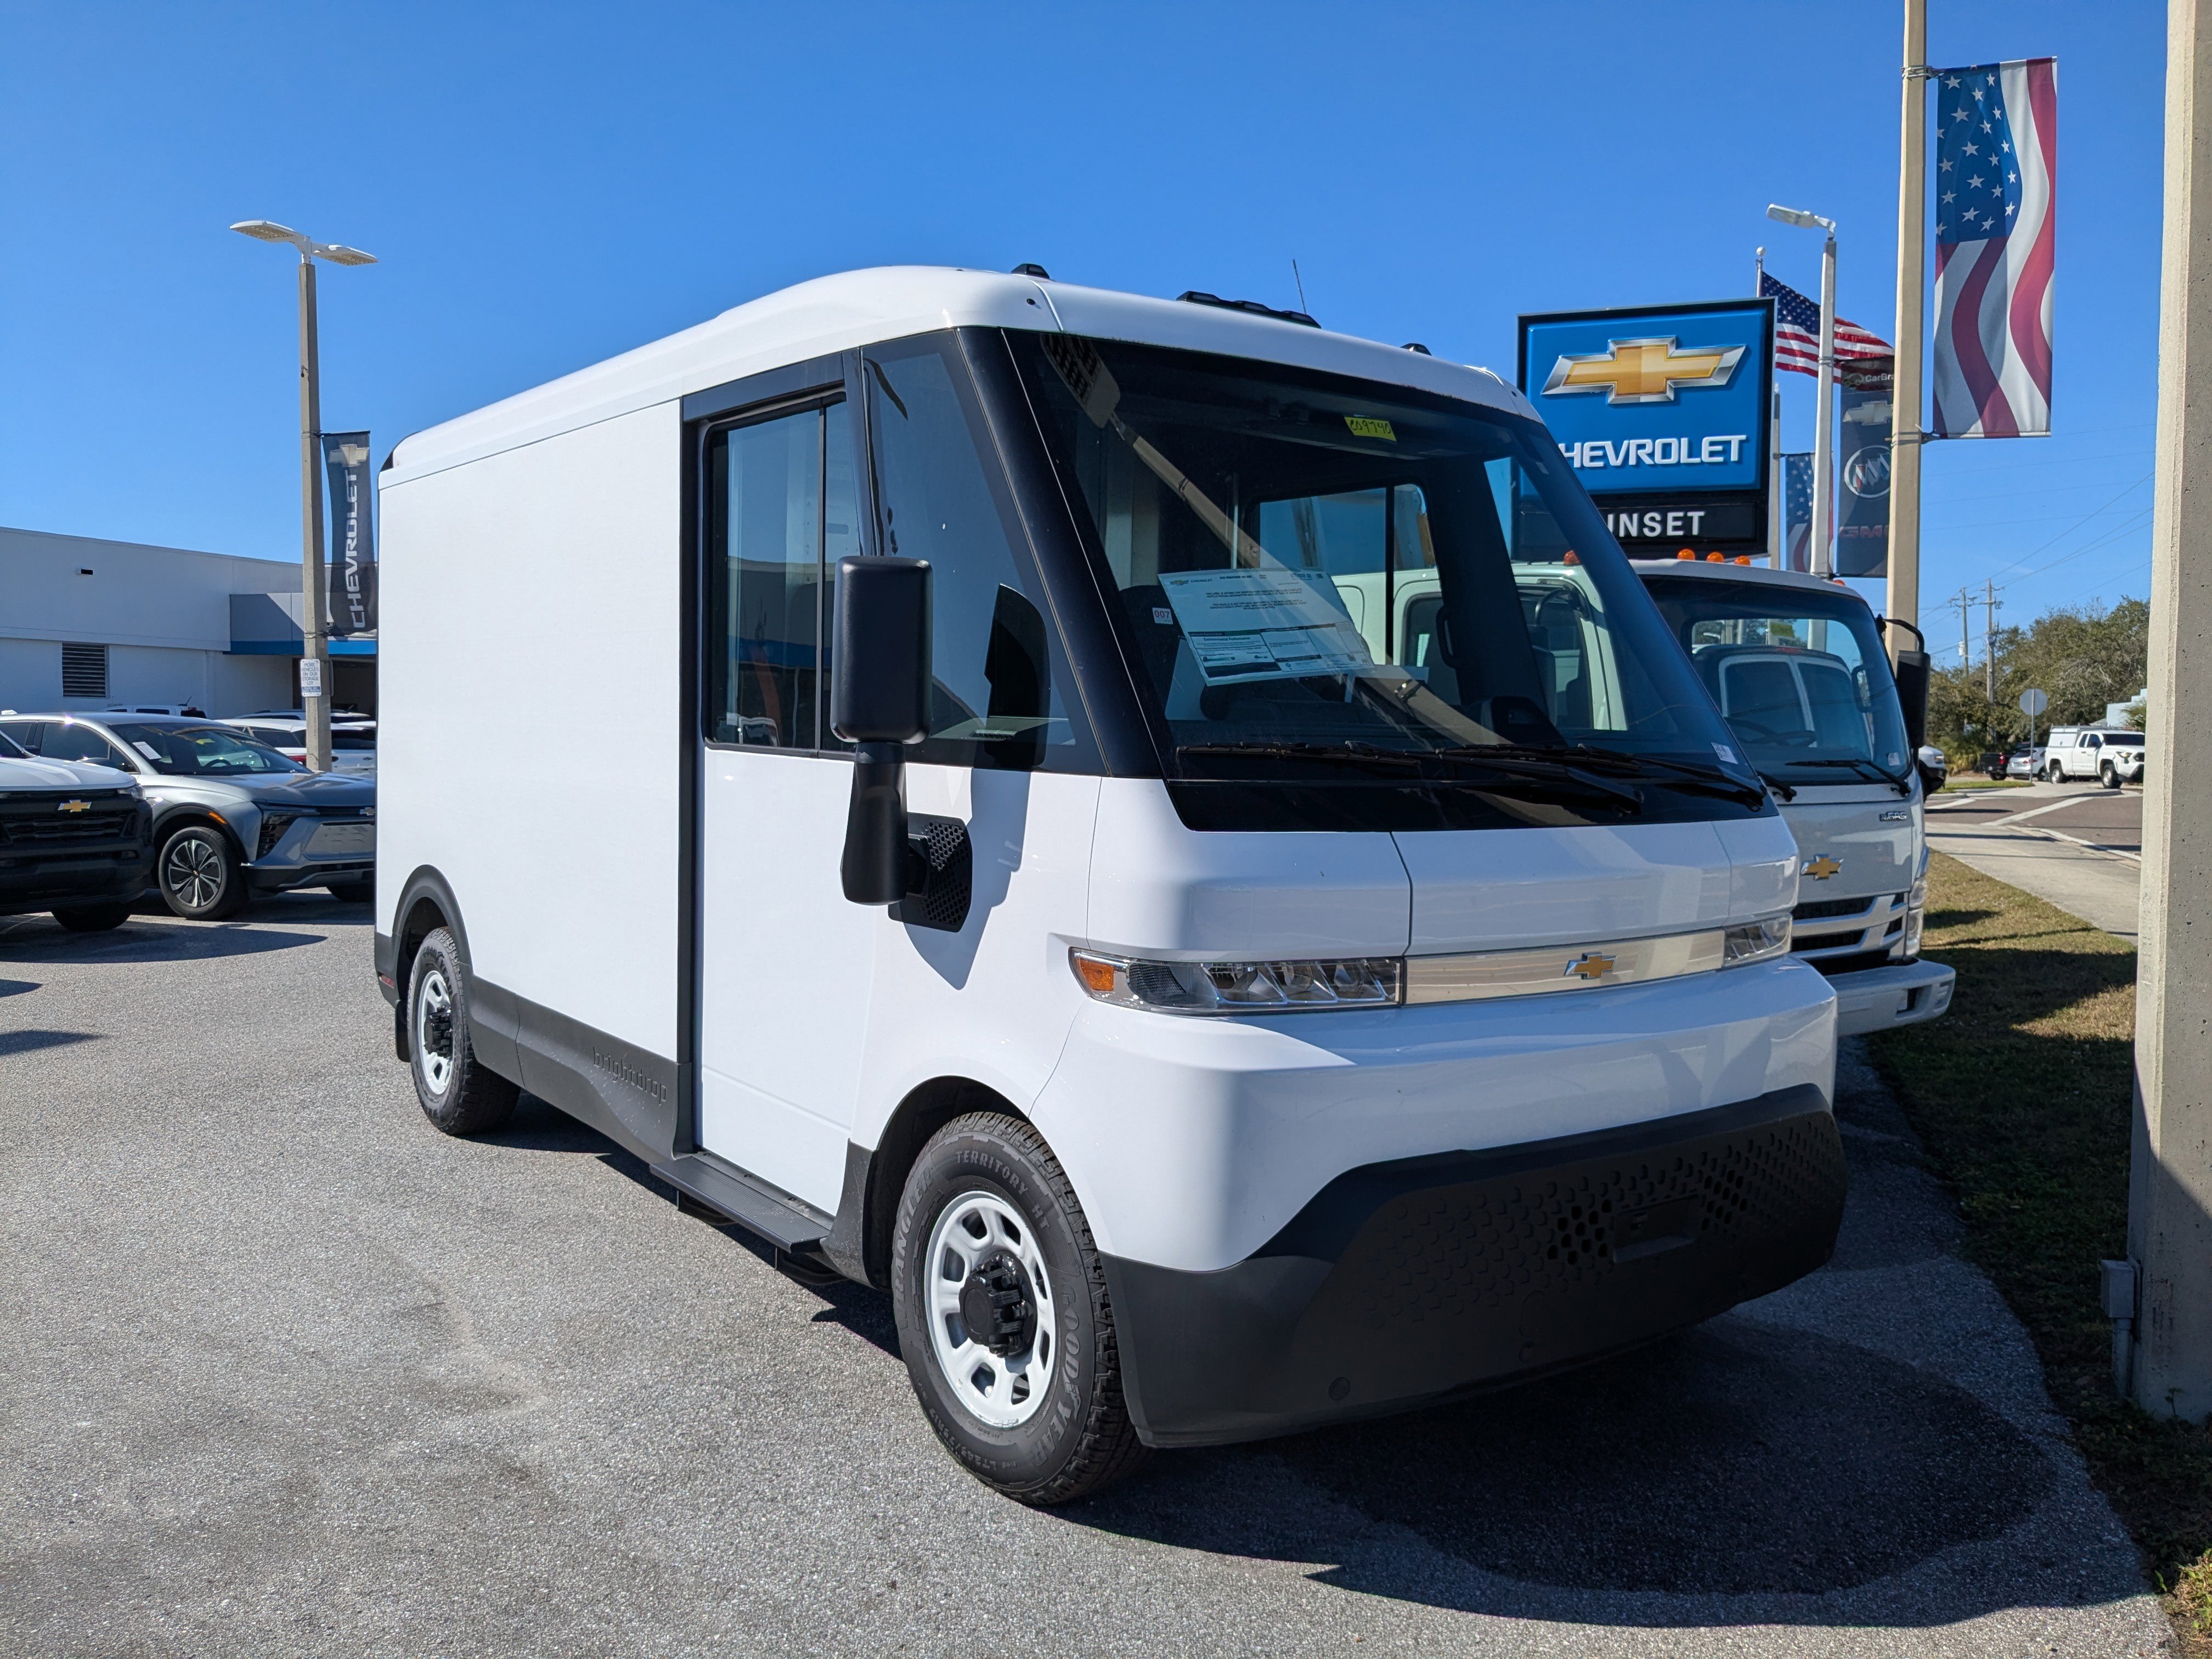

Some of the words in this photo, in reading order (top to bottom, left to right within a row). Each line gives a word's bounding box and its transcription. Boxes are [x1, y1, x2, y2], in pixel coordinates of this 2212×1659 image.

[1865, 373, 1894, 382] CarBra
[1558, 434, 1747, 468] HEVROLET
[345, 469, 365, 628] CHEVROLET
[1607, 511, 1705, 538] NSET
[1154, 610, 1170, 619] 007
[956, 1150, 1030, 1195] TERRITORY
[1032, 1204, 1051, 1229] HT
[894, 1167, 932, 1331] WRANGLER
[1031, 1282, 1081, 1466] GOODYEAR
